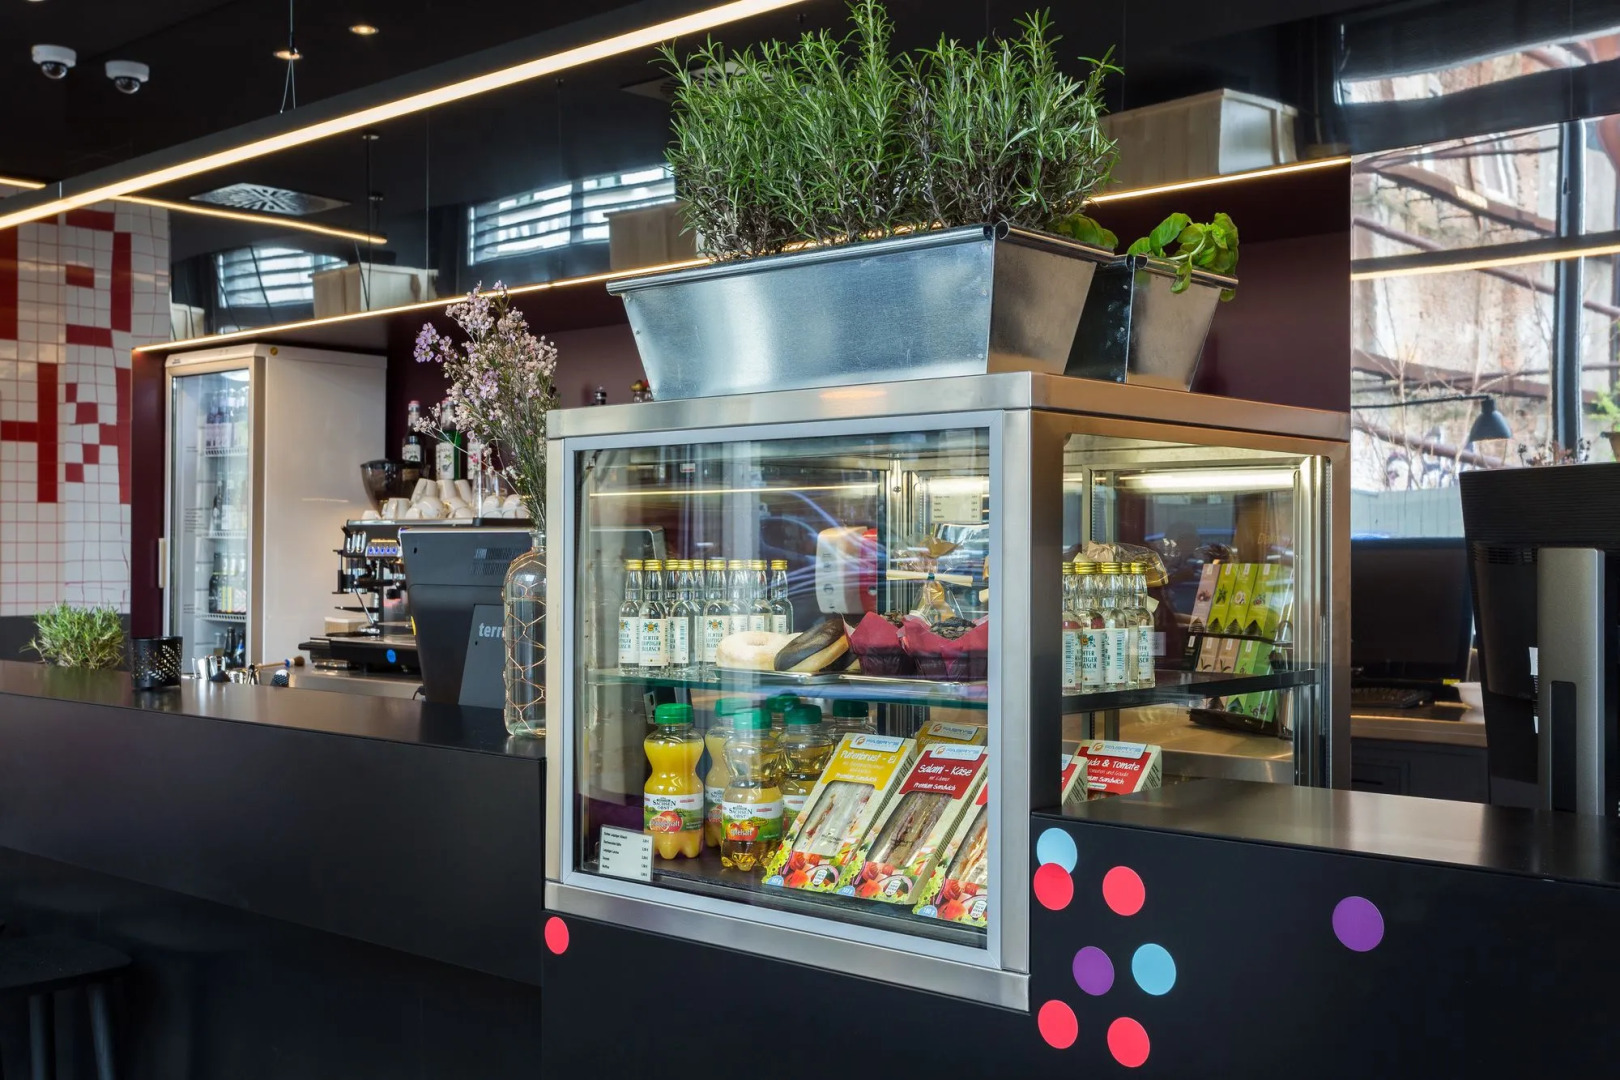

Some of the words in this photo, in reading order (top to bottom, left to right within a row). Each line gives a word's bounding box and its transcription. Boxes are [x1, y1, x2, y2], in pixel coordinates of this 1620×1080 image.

[478, 622, 503, 638] terr
[918, 764, 945, 774] Salami
[950, 766, 973, 776] Käse
[1102, 759, 1110, 767] &
[1113, 761, 1140, 771] Tomate
[1098, 777, 1125, 785] Sandwich
